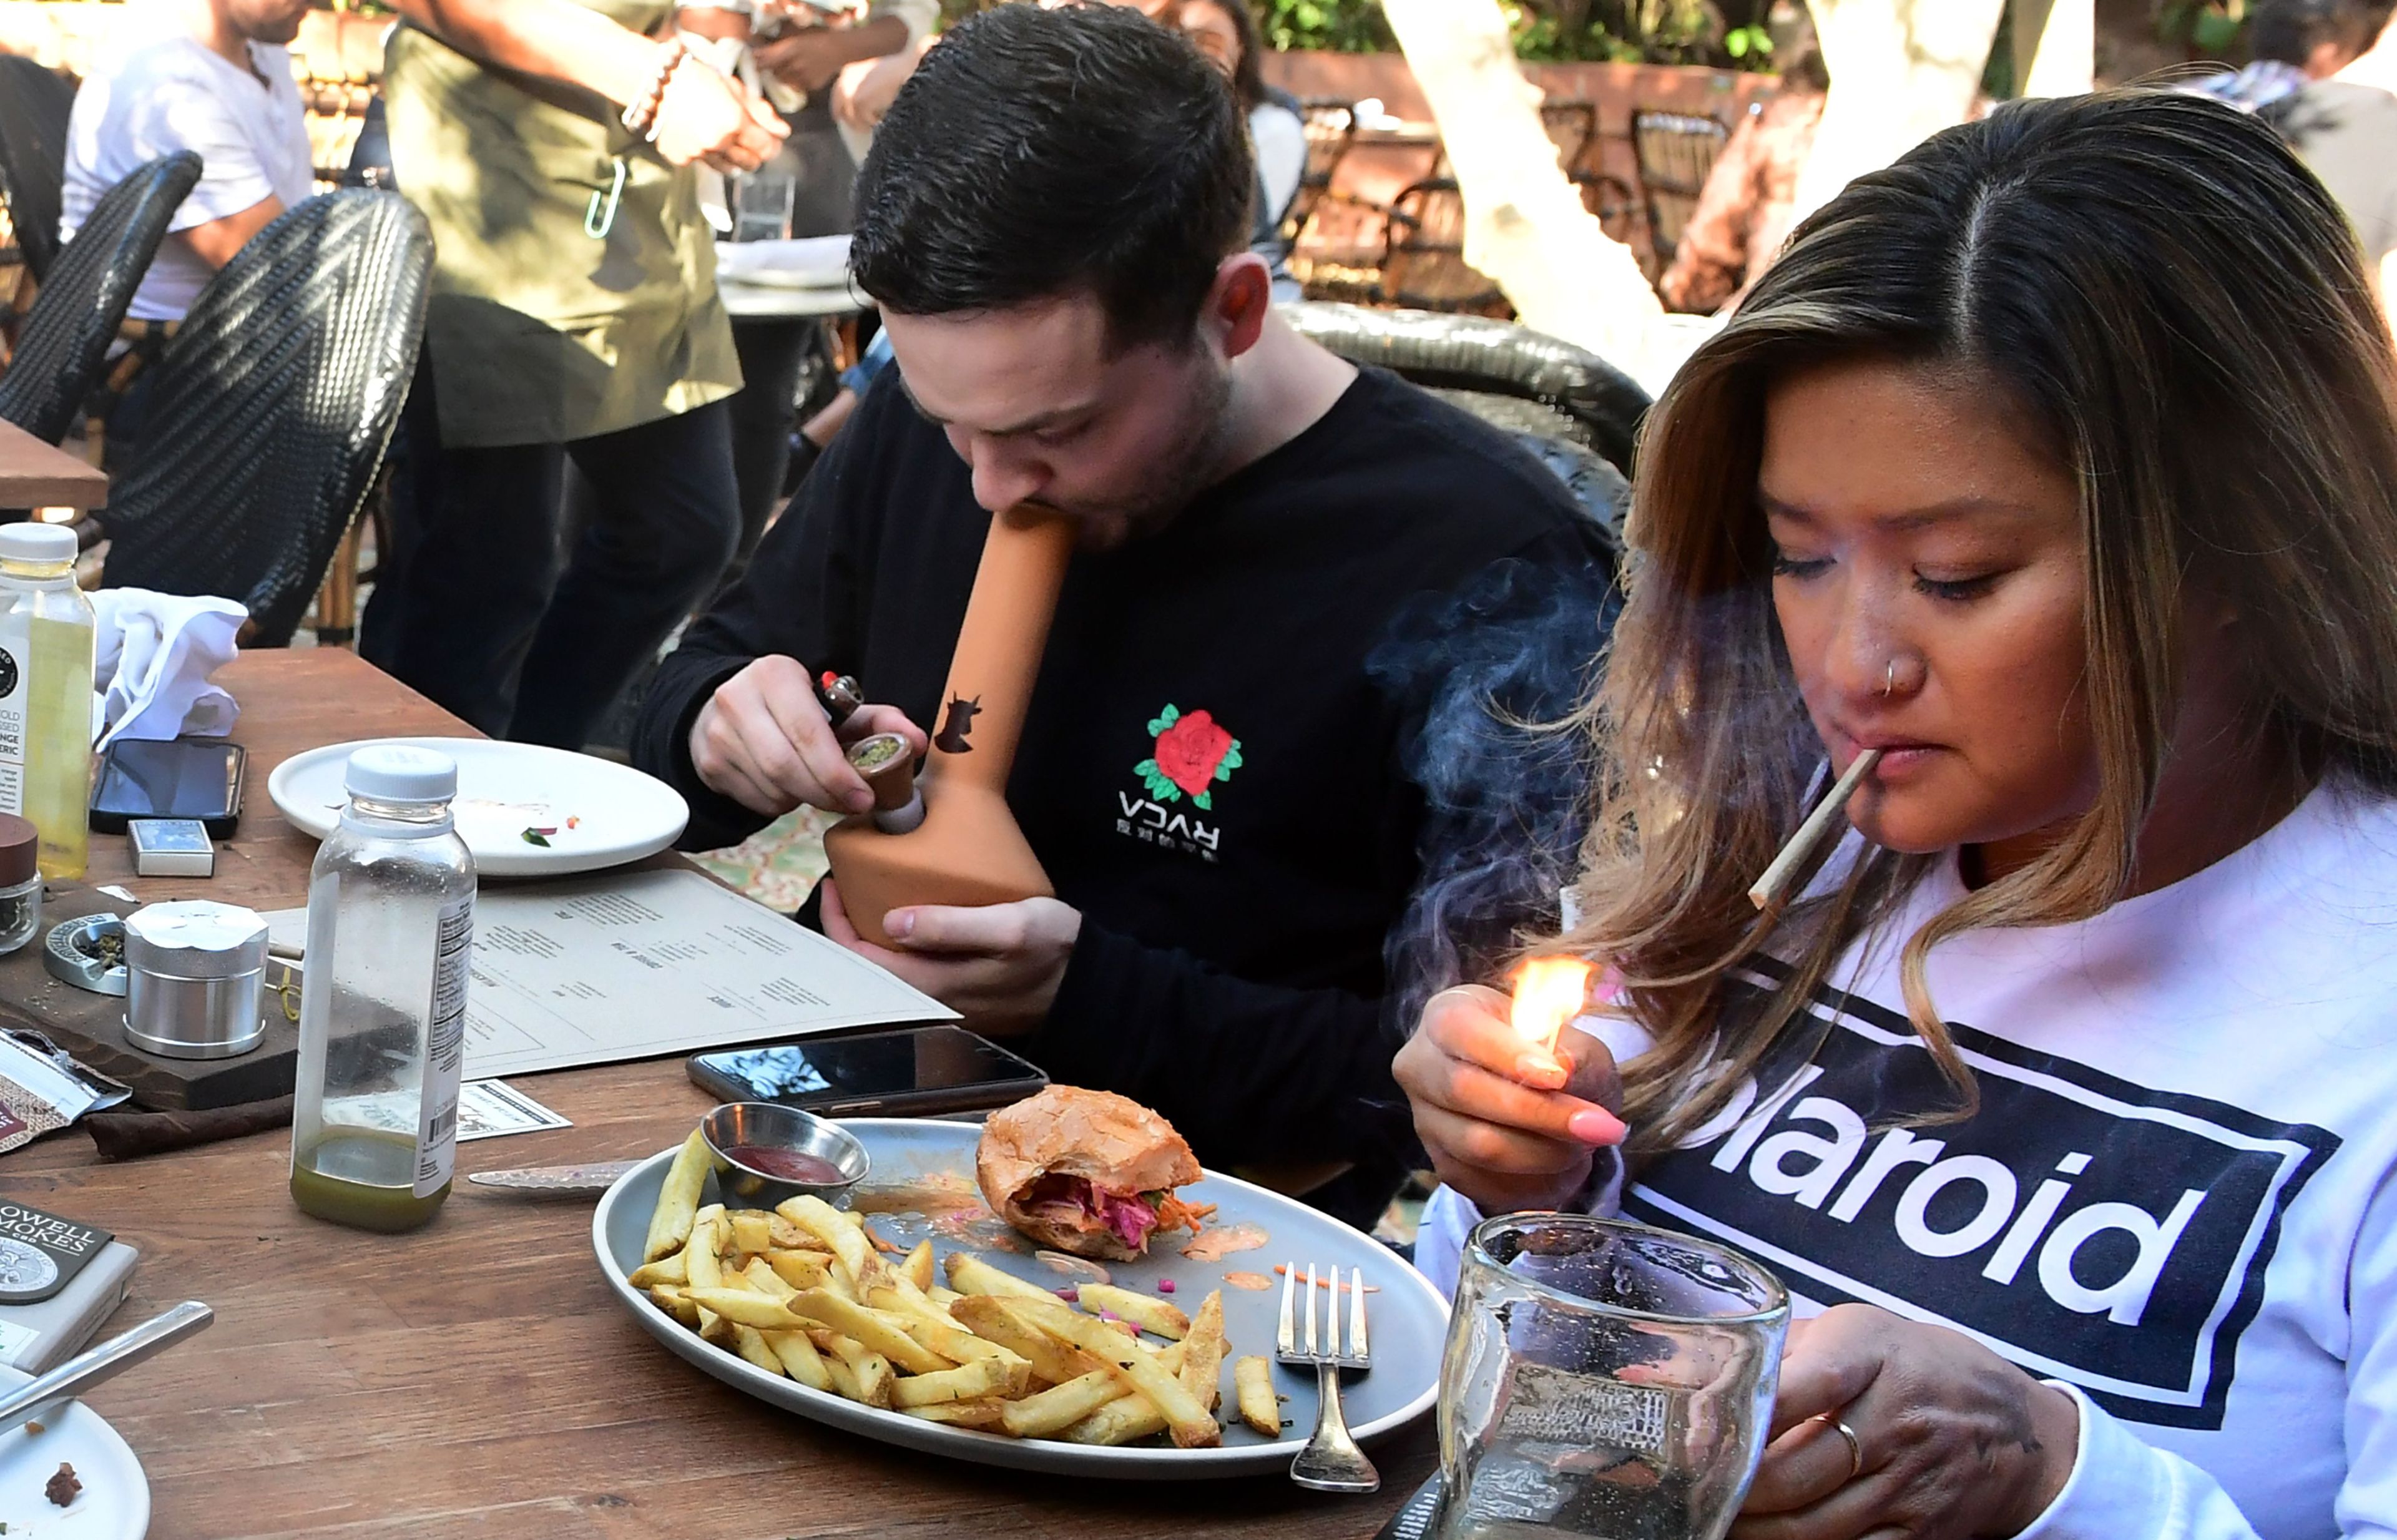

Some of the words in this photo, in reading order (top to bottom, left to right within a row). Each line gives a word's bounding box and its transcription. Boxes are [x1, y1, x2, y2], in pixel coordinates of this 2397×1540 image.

[0, 709, 20, 721] OLD
[1119, 790, 1220, 851] RVCA
[1659, 1024, 2207, 1326] olaroid
[0, 1206, 95, 1243] OWELL
[0, 1215, 87, 1252] MOKES
